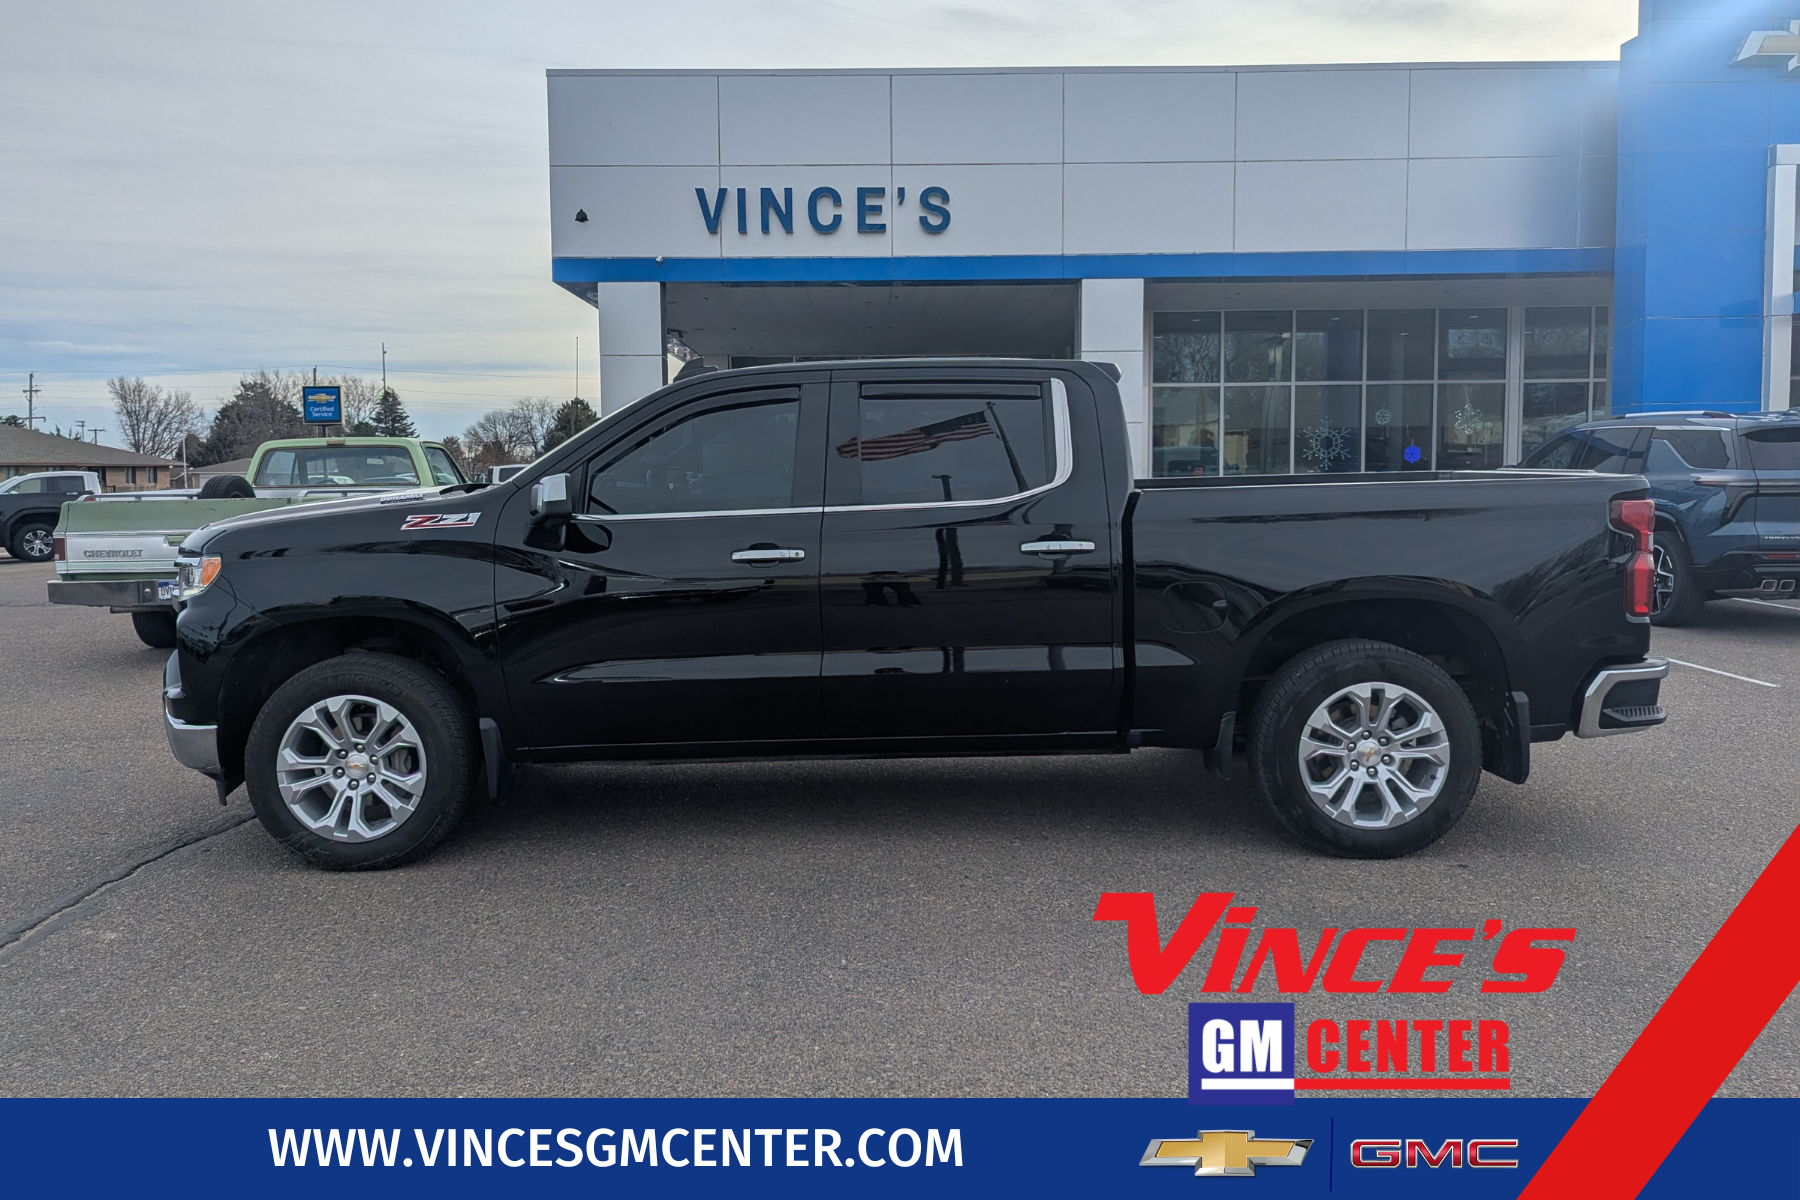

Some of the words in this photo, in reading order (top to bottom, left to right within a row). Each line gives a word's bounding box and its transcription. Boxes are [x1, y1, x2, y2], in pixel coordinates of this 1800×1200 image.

[695, 186, 951, 234] VINCE'S
[400, 512, 482, 530] Z71
[83, 549, 143, 558] CHEVROLET
